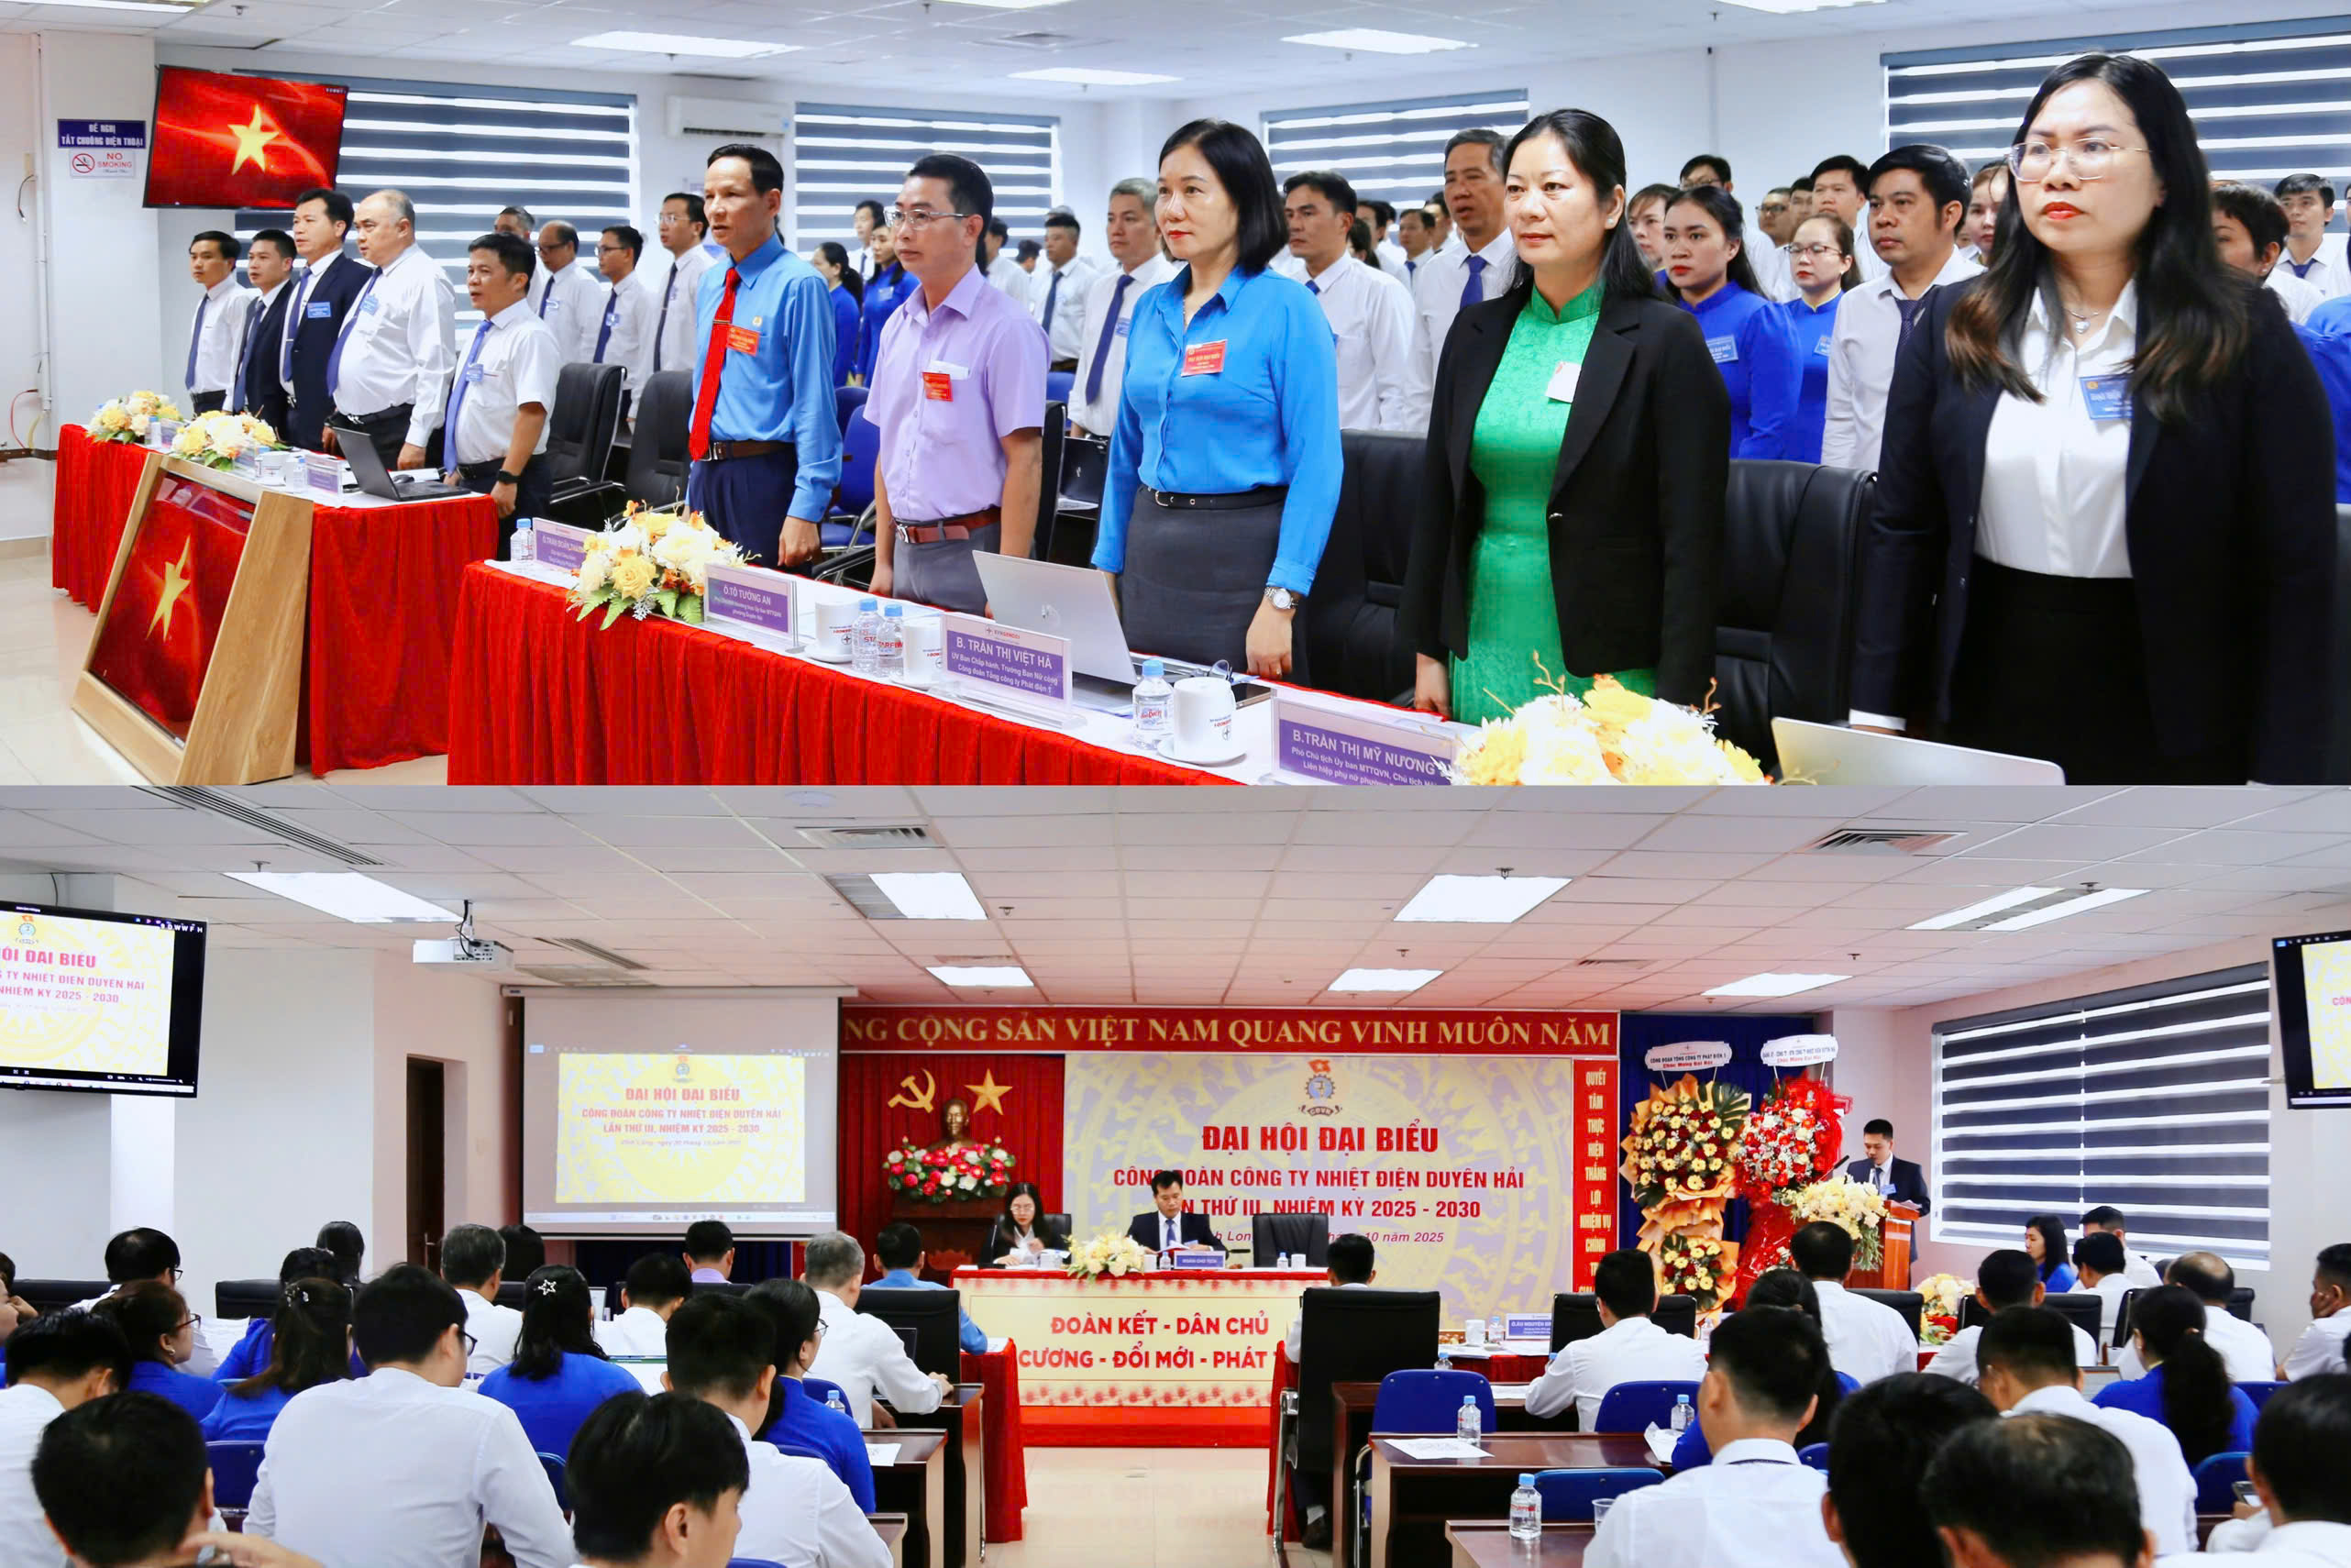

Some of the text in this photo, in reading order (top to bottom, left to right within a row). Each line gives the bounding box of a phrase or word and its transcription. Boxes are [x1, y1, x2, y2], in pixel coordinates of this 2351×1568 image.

[106, 152, 123, 160] NO
[956, 636, 966, 649] B.
[968, 640, 993, 655] TRẦN
[996, 646, 1010, 662] THỊ
[1013, 649, 1034, 666] VIỆT
[1038, 653, 1053, 669] HÀ
[1292, 746, 1305, 757] Phó
[1346, 761, 1358, 770] ban
[1303, 761, 1318, 771] Liên
[1319, 764, 1333, 776] hiệp
[1341, 741, 1360, 759] THỊ
[1385, 753, 1435, 776] NƯƠNG
[7, 970, 18, 980] TY
[55, 990, 82, 1000] 2025
[94, 992, 119, 1003] 2030
[897, 1014, 987, 1047] CỘNG
[996, 1011, 1056, 1042] SẢN
[1066, 1013, 1139, 1047] VIỆT
[1148, 1019, 1219, 1042] NAM
[1231, 1020, 1341, 1047] QUANG
[1352, 1021, 1427, 1044] VINH
[1438, 1017, 1531, 1045] MUÔN
[1540, 1018, 1610, 1045] NĂM
[668, 1110, 677, 1118] TY
[707, 1124, 729, 1133] 2025
[737, 1124, 760, 1133] 2030
[1202, 1119, 1438, 1156] ĐẠI HỘI ĐẠI BIỂU
[1231, 1166, 1282, 1187] CÔNG
[1288, 1170, 1309, 1187] TY
[1316, 1166, 1370, 1191] NHIỆT
[1376, 1167, 1419, 1191] ĐIỆN
[1427, 1168, 1486, 1187] DUYÊN
[1493, 1166, 1524, 1188] HẢI
[1201, 1196, 1238, 1216] THỨ
[1342, 1197, 1364, 1217] KỲ
[1372, 1201, 1416, 1218] 2025
[1436, 1201, 1481, 1218] 2030
[1228, 1231, 1251, 1241] Lon
[1383, 1232, 1410, 1242] năm
[1414, 1232, 1443, 1242] 2025
[1051, 1312, 1111, 1335] ĐOÀN
[1119, 1309, 1158, 1335] KẾT
[1176, 1312, 1220, 1335] DÂN
[1226, 1310, 1269, 1335] CHỦ
[1019, 1348, 1094, 1368] CƯƠNG
[1112, 1341, 1149, 1368] ĐỔI
[1155, 1346, 1194, 1368] MỚI
[1213, 1344, 1268, 1368] PHÁT
